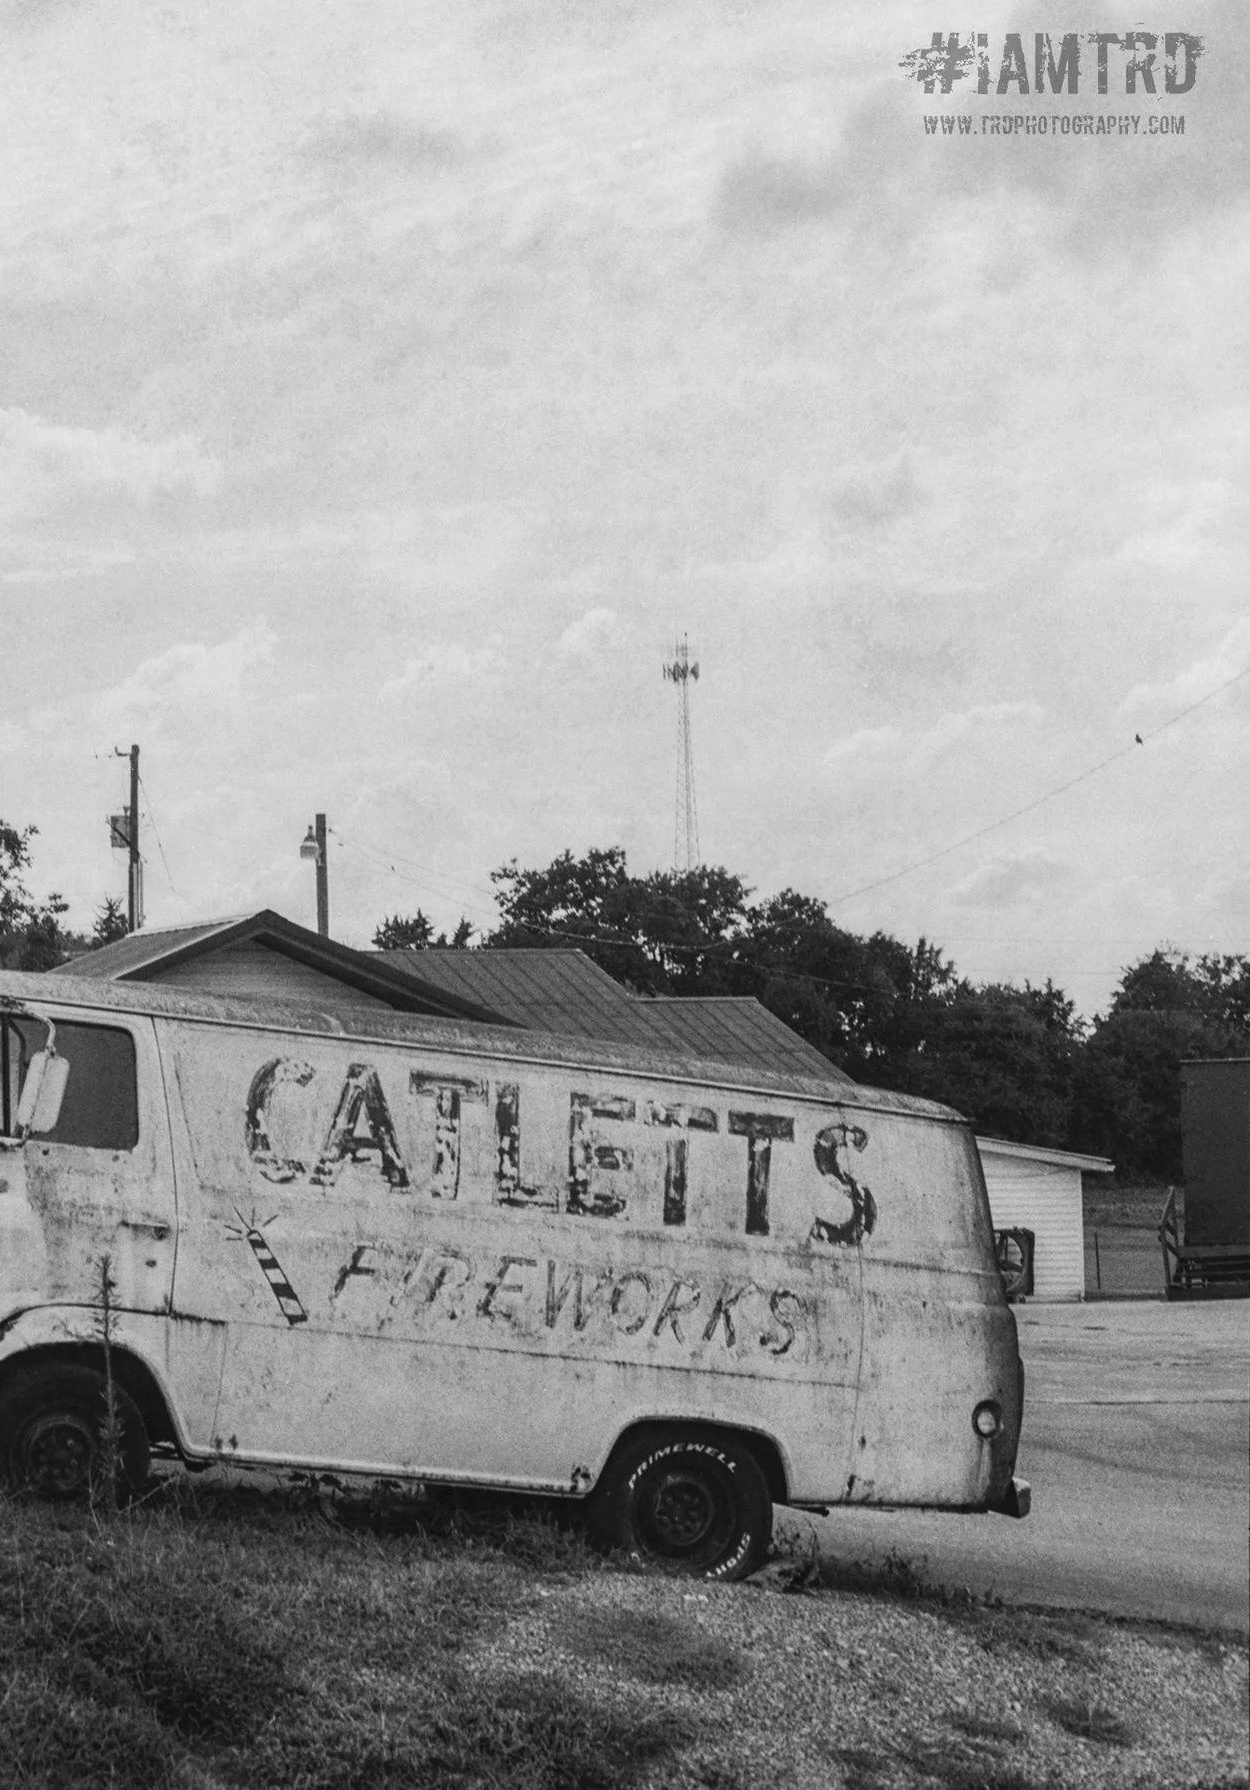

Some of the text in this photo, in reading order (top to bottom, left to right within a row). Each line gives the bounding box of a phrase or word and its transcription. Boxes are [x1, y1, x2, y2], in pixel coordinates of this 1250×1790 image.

[244, 1057, 878, 1249] CATLETTS
[327, 1243, 809, 1355] FIREWORKS
[628, 1442, 737, 1490] PRIMEWELL
